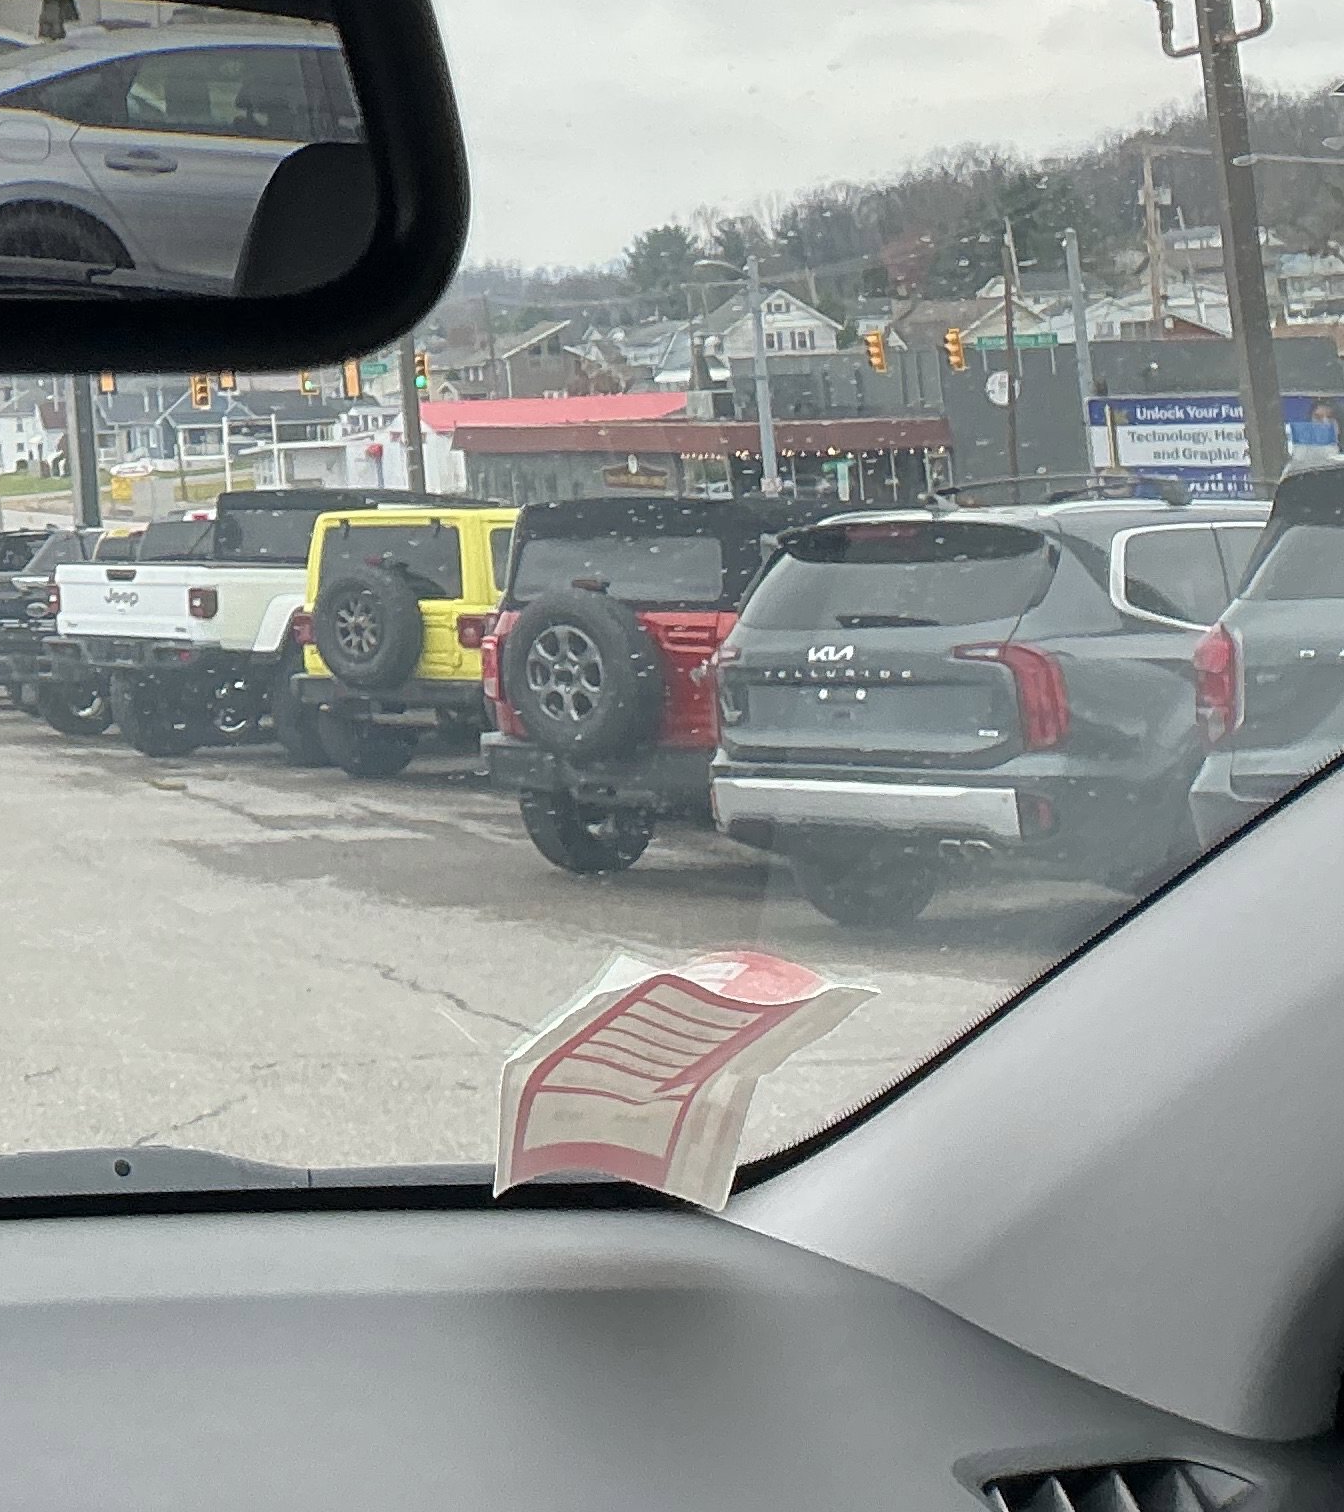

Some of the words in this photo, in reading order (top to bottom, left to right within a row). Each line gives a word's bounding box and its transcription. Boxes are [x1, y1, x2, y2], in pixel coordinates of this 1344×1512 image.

[1135, 405, 1186, 421] Unlock
[1186, 405, 1219, 419] Your
[1153, 448, 1179, 460] and
[104, 587, 139, 607] Jeep
[807, 644, 855, 662] KIA
